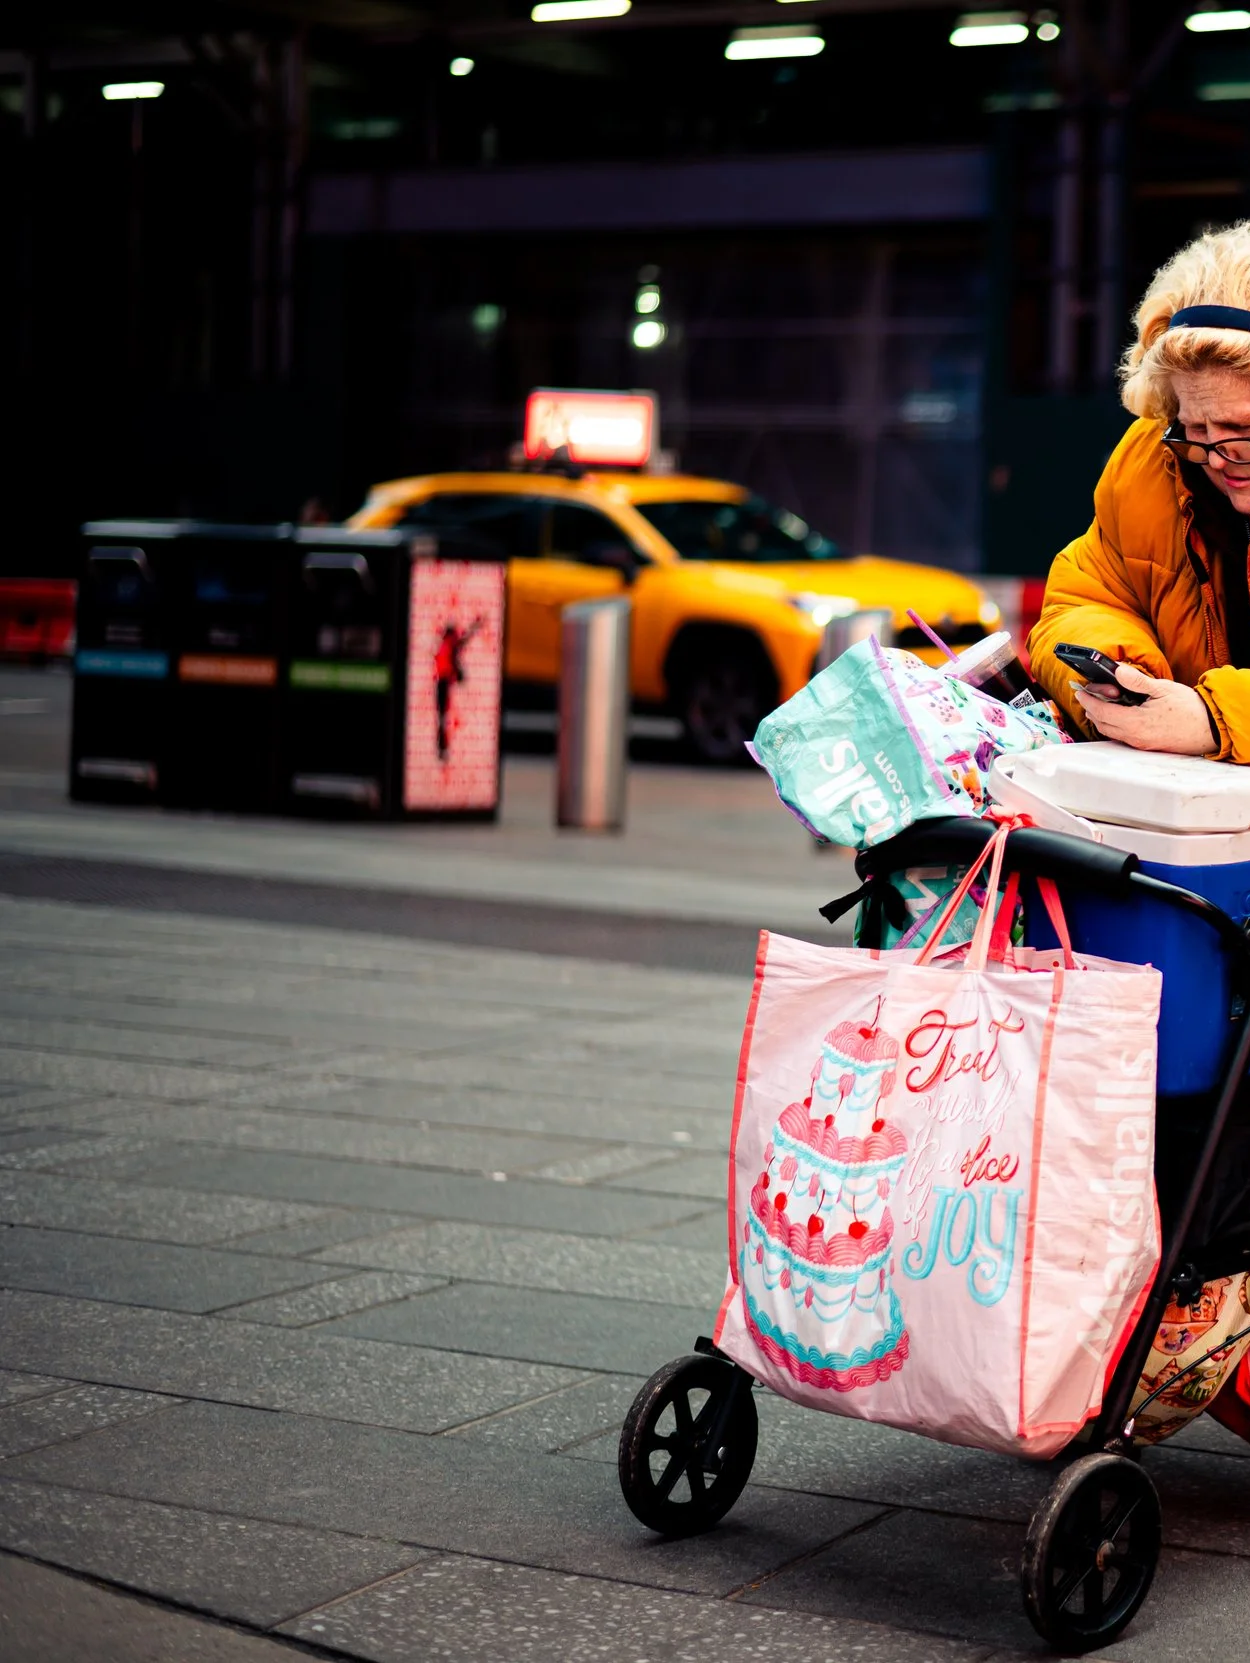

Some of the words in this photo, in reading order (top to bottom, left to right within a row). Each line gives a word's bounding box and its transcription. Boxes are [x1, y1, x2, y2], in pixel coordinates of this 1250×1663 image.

[905, 1006, 1025, 1093] Treat
[959, 1134, 1020, 1188] slice
[1076, 1048, 1154, 1363] Marshalls
